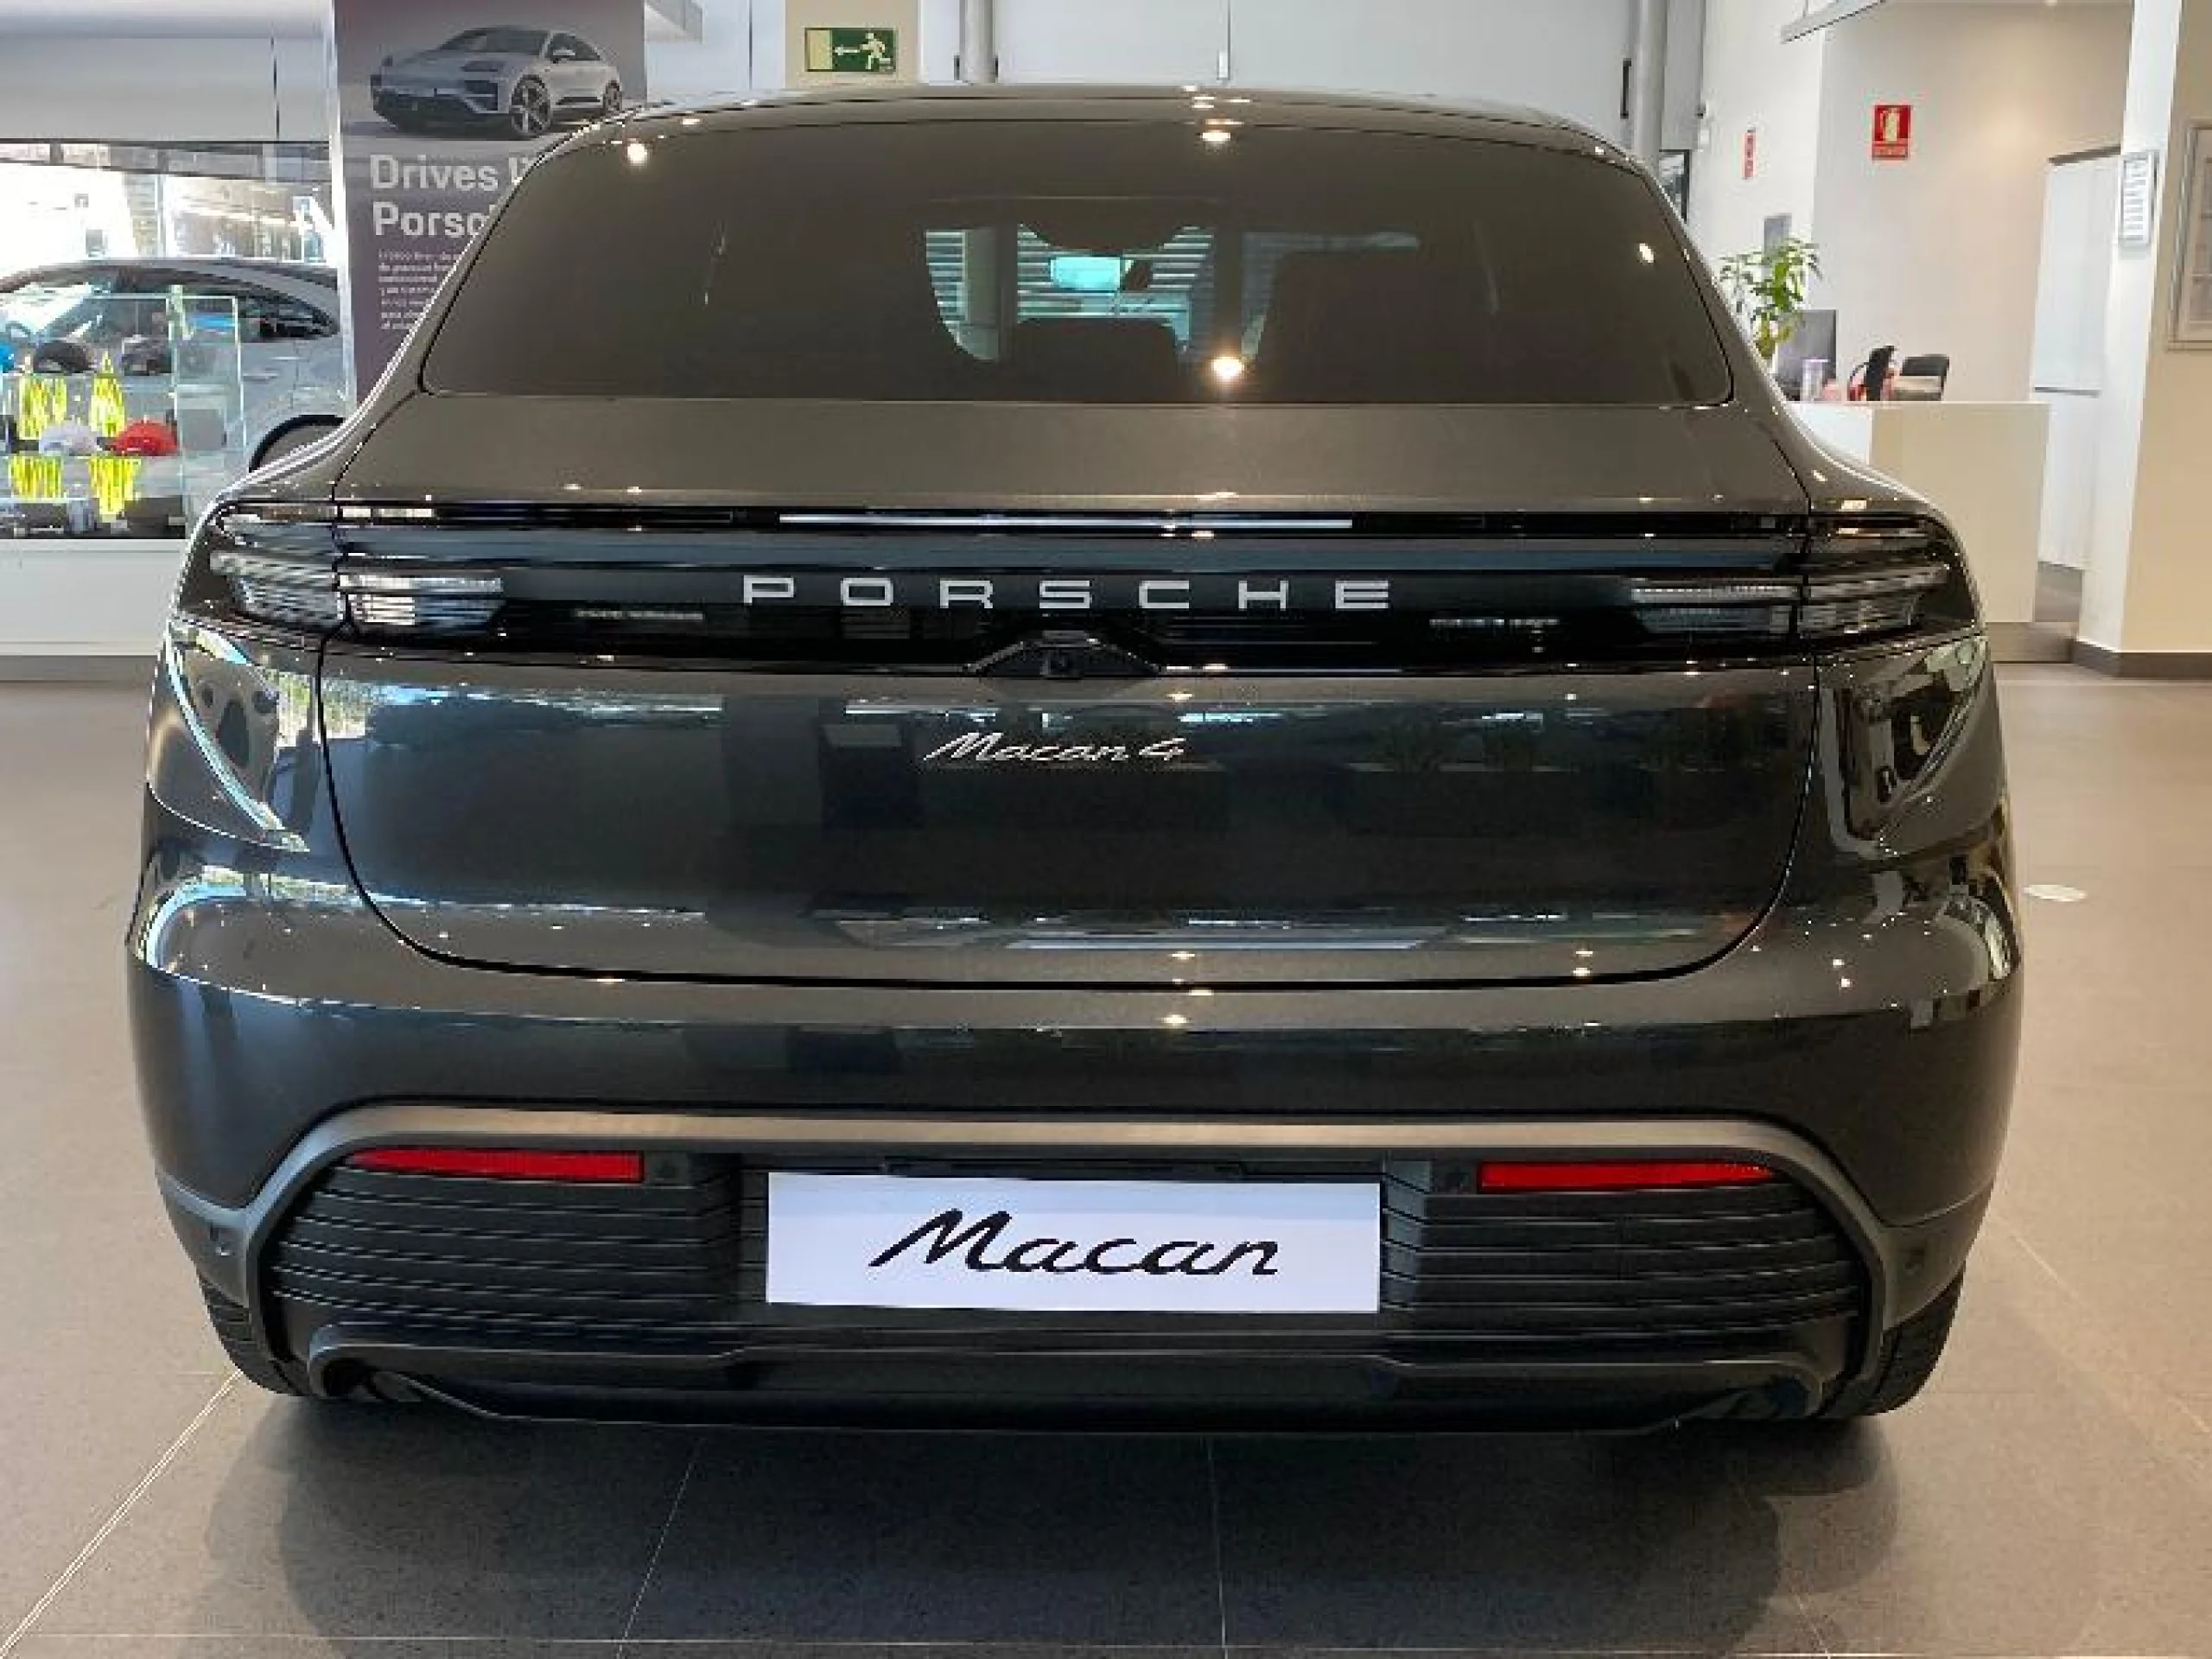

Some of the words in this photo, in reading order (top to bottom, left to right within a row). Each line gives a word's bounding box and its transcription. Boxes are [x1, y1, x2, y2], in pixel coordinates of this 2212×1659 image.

[370, 154, 499, 192] Drives
[372, 201, 497, 238] Porsc
[741, 574, 1390, 610] PORSCHE
[924, 732, 1129, 760] Macan
[1138, 737, 1186, 761] 4
[868, 1208, 1279, 1275] Macan
